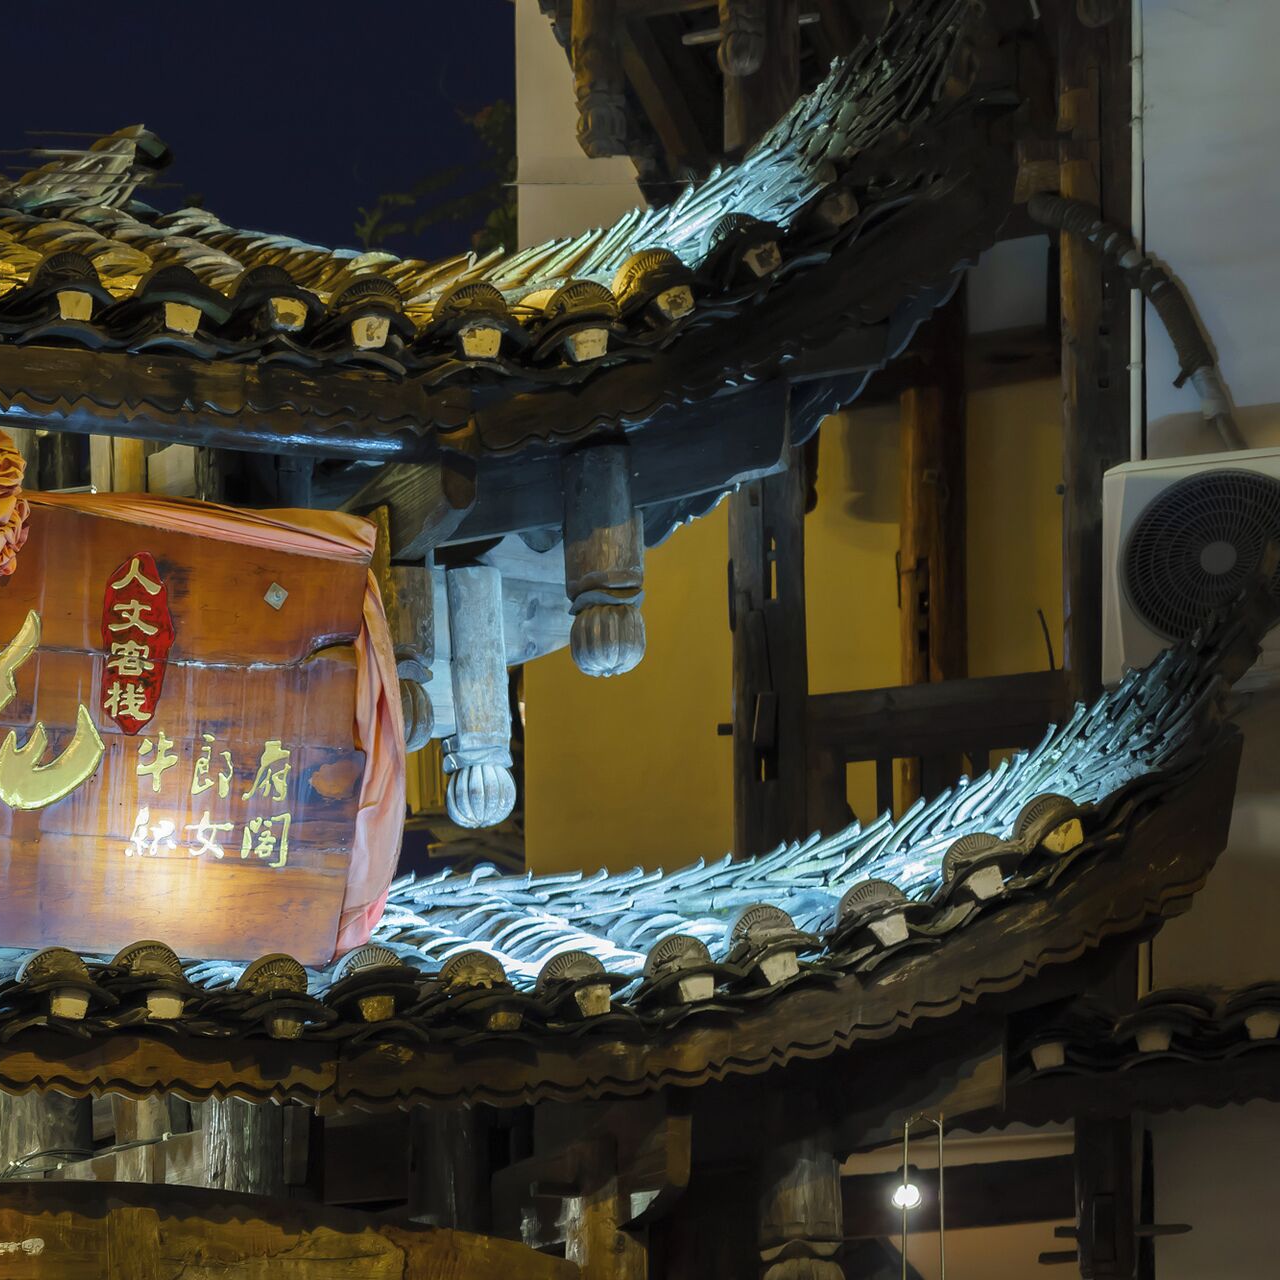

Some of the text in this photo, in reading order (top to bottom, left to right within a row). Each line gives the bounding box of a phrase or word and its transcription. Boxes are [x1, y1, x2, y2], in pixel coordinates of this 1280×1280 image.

[103, 557, 162, 721] 人文客栈
[136, 731, 291, 802] 牛郎府
[124, 806, 291, 869] 织女阁
